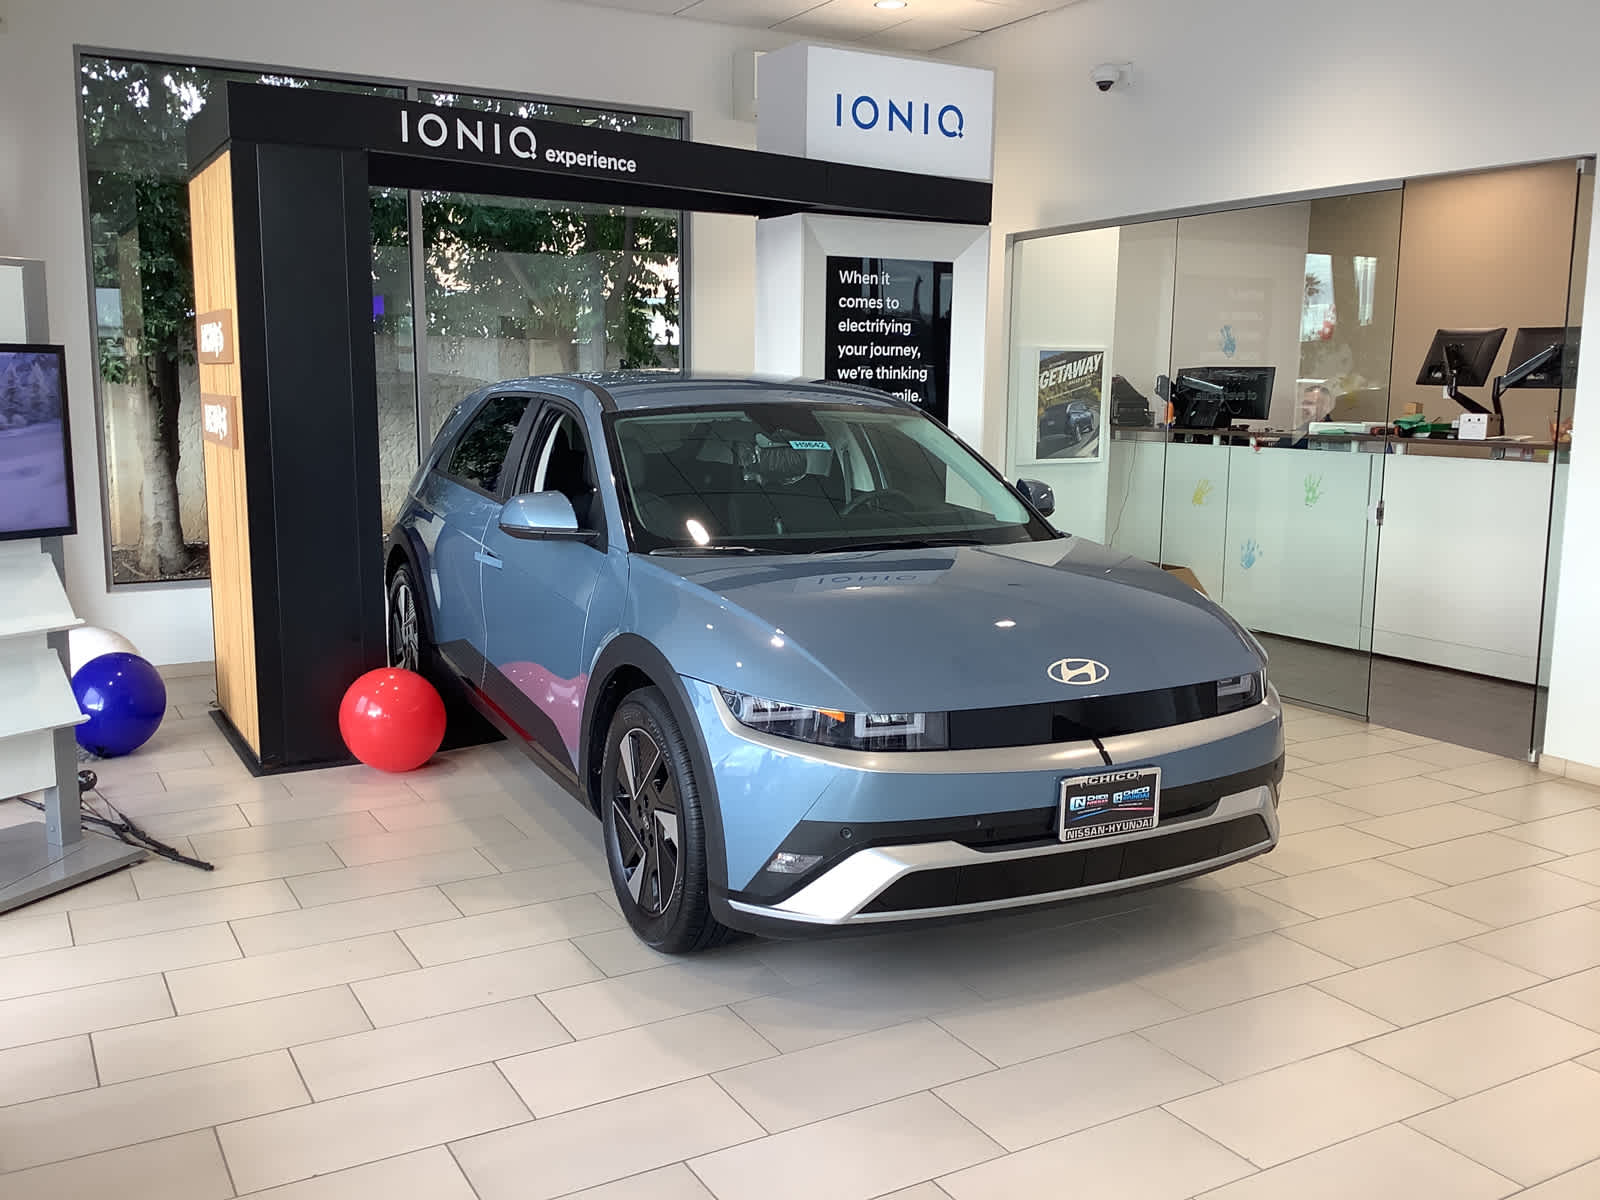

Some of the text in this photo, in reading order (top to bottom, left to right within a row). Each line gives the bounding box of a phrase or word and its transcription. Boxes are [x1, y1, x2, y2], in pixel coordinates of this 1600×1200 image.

[836, 93, 964, 139] IONIQ
[401, 110, 637, 173] IONIQ experience
[839, 270, 890, 285] When it
[838, 297, 900, 309] comes to
[838, 318, 911, 336] electrifying
[837, 342, 921, 359] your journey,
[837, 366, 928, 382] we're thinking
[1040, 352, 1103, 390] GETAWAY
[1087, 771, 1138, 785] CHICO
